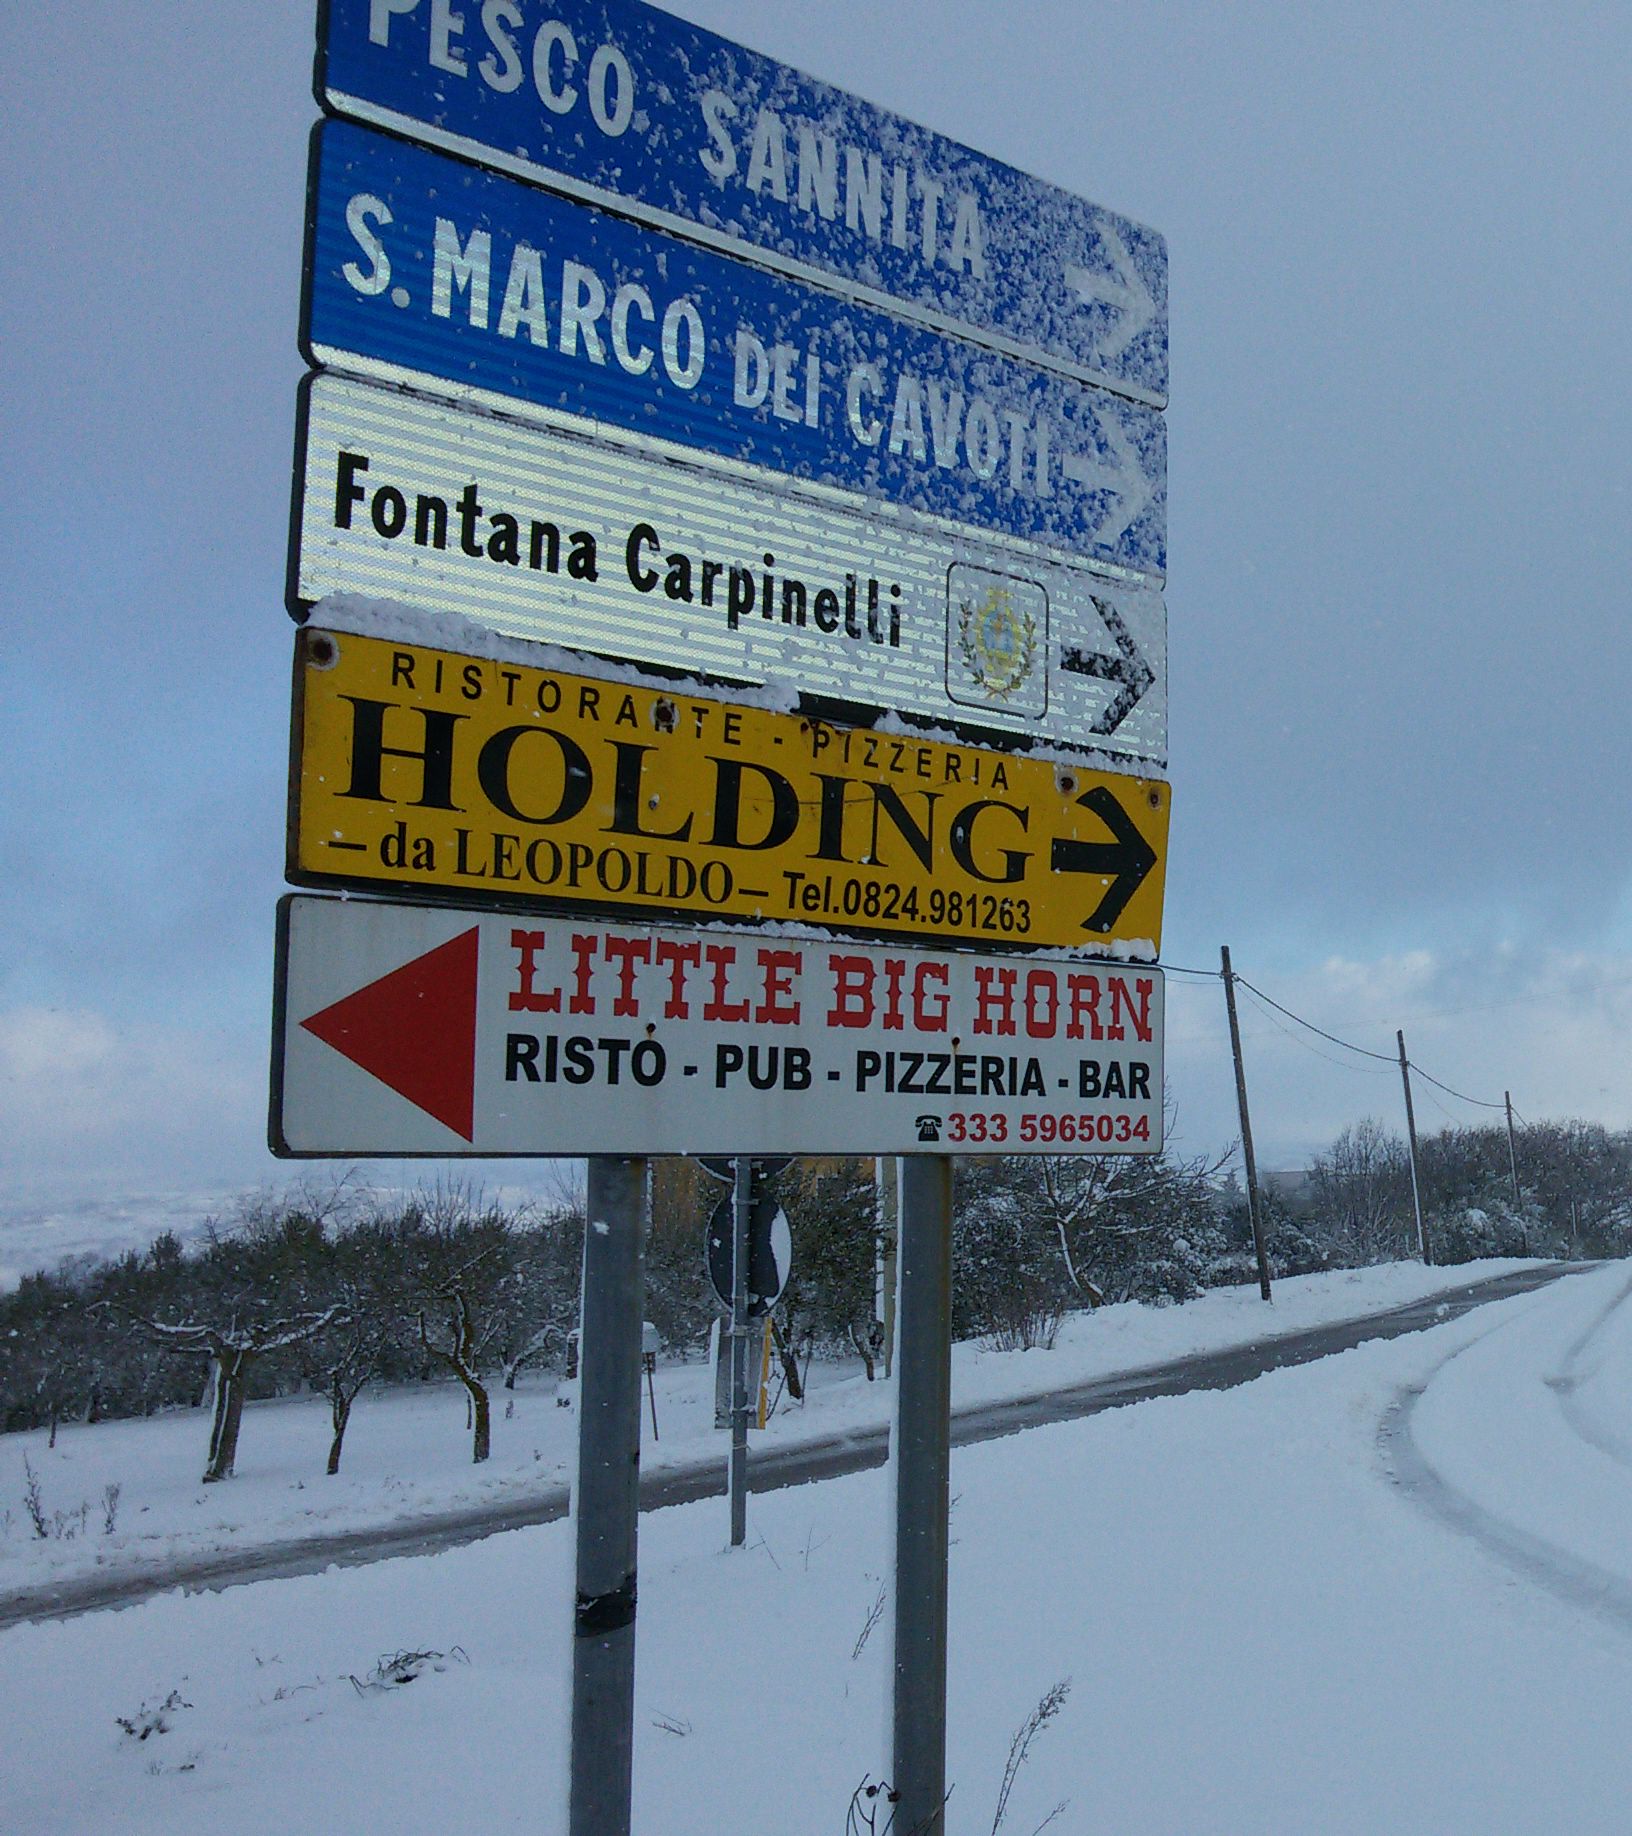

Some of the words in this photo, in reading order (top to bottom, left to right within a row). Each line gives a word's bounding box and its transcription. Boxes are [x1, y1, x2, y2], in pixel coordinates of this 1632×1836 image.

[699, 91, 985, 280] SANNITA
[342, 194, 410, 308] S.
[431, 216, 705, 390] MARCO
[734, 329, 820, 428] DEI
[847, 362, 1049, 498] CAVOTI
[334, 451, 599, 582] Fontana
[625, 523, 901, 648] Carpinelli
[332, 694, 1035, 884] HOLDING
[812, 726, 1009, 790] PIZZERIA
[380, 821, 436, 871] da
[454, 829, 734, 904] LEOPOLDO
[783, 871, 1032, 934] Tel.0824.981263
[508, 929, 802, 1026] LITTLE
[827, 954, 950, 1035] BIG
[973, 965, 1154, 1042] HORN
[505, 1033, 667, 1087] RISTO
[716, 1044, 812, 1091] PUB
[856, 1050, 1047, 1097] PIZZERIA
[1079, 1060, 1151, 1099] BAR
[947, 1113, 1008, 1142] 333
[1020, 1114, 1151, 1143] 5965034
